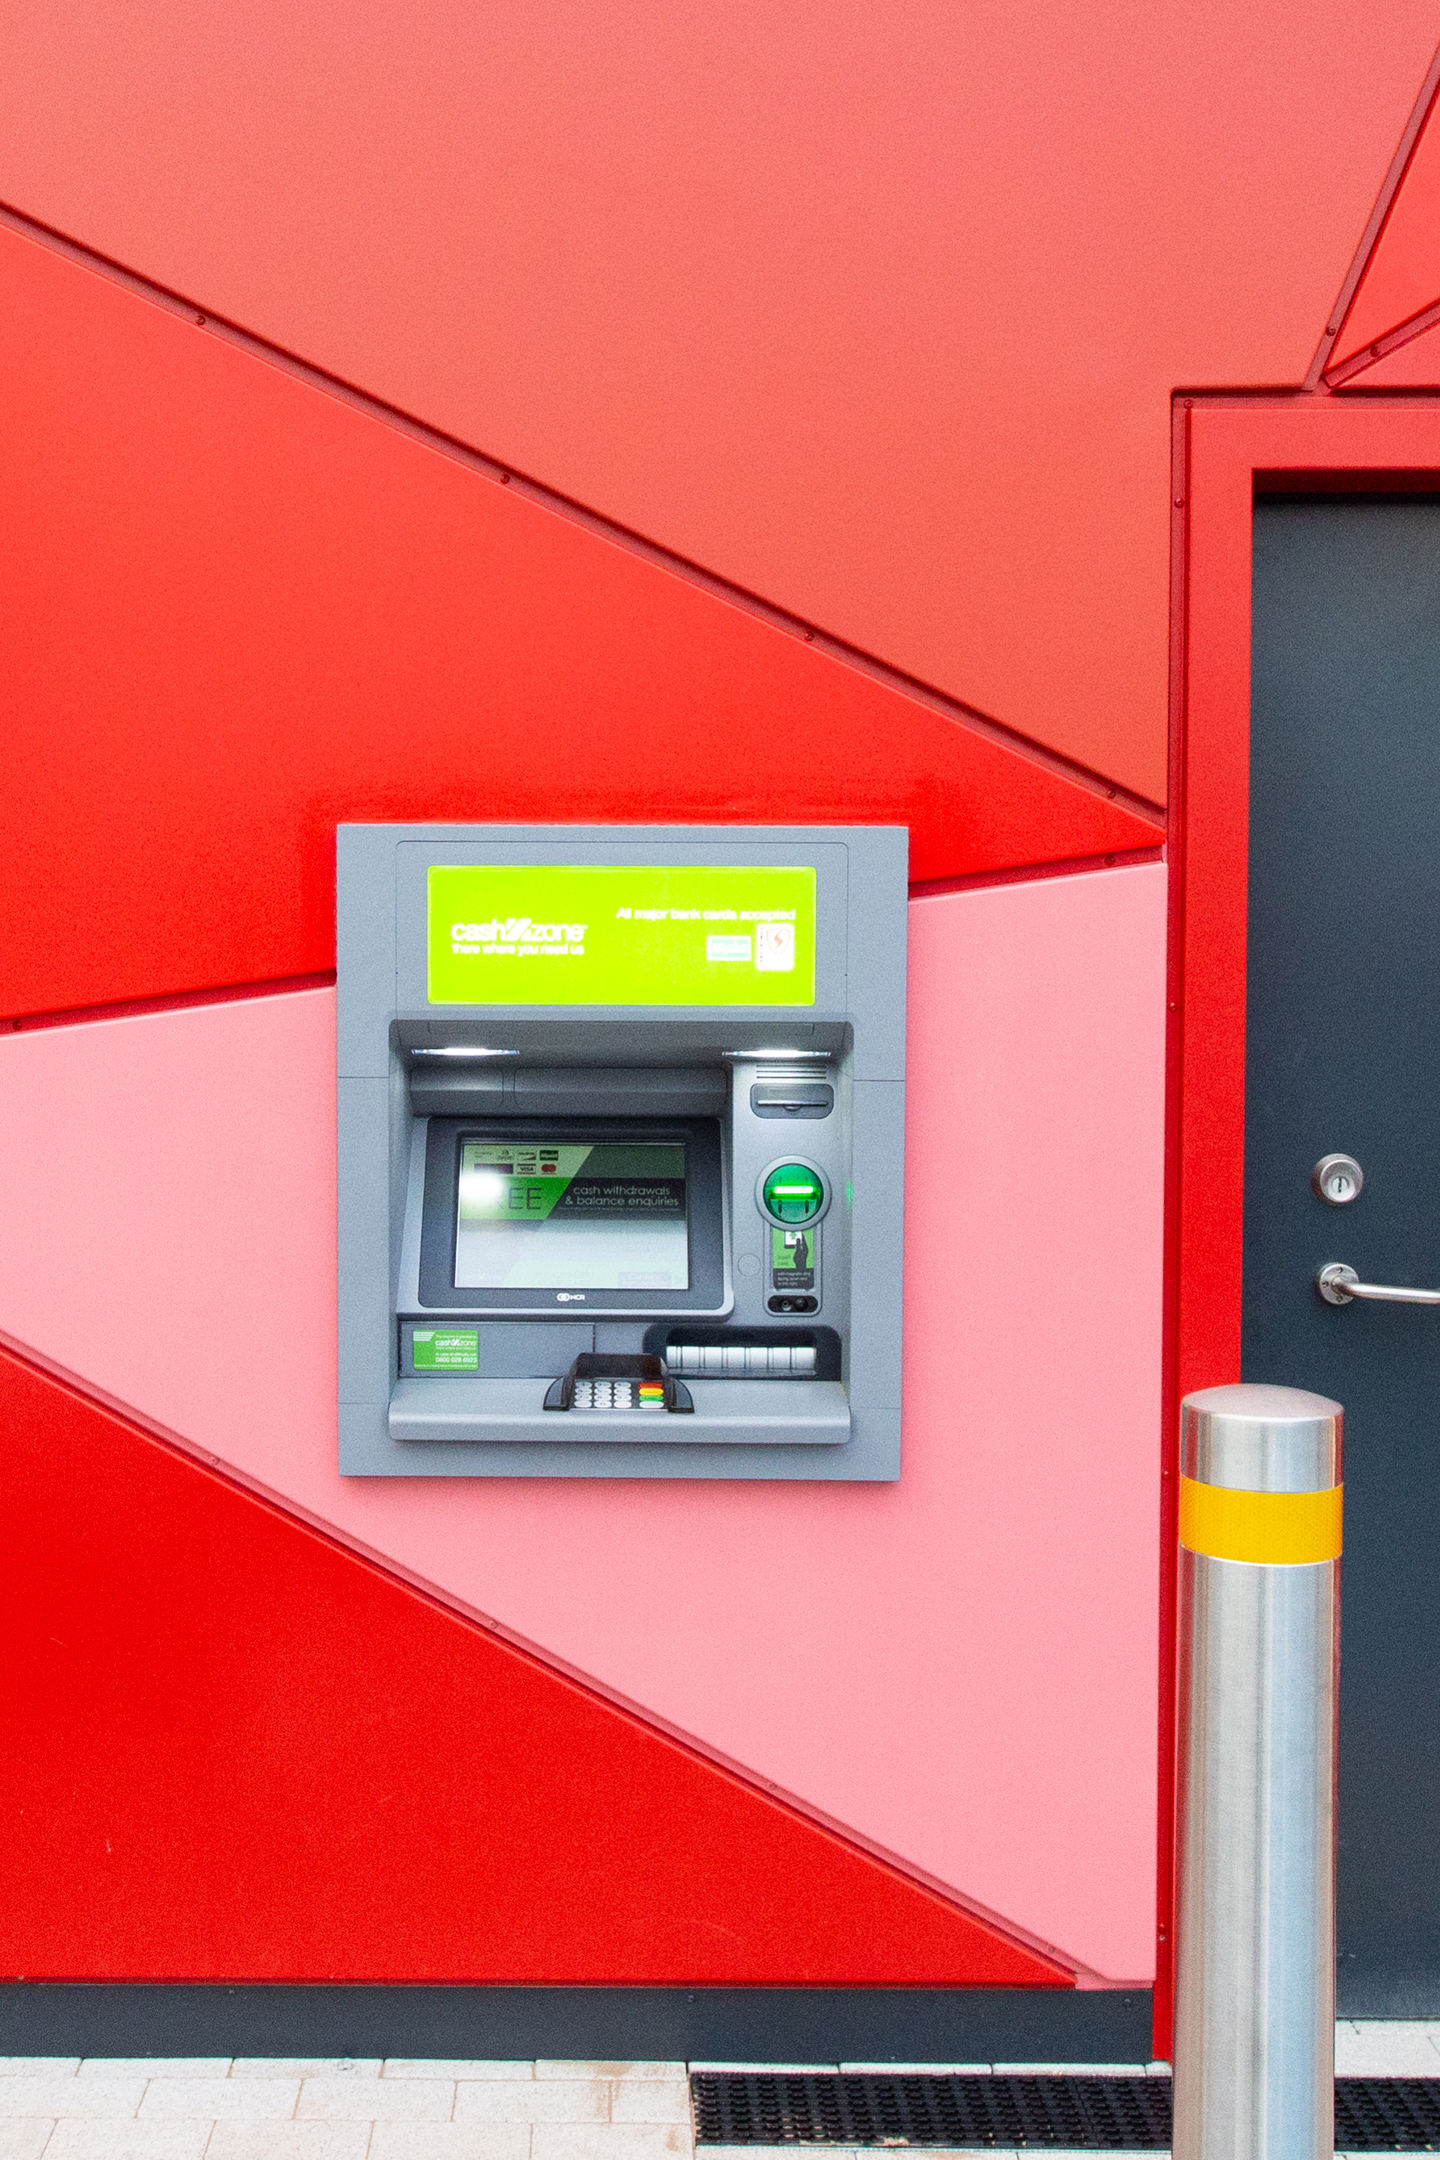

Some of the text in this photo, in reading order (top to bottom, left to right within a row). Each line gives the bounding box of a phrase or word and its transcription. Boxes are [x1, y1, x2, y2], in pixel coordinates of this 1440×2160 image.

[616, 907, 796, 922] All major bank cards accepted
[452, 943, 584, 957] there where you need us
[573, 1185, 670, 1195] cash withdrawals
[565, 1196, 679, 1208] & balance enquiries
